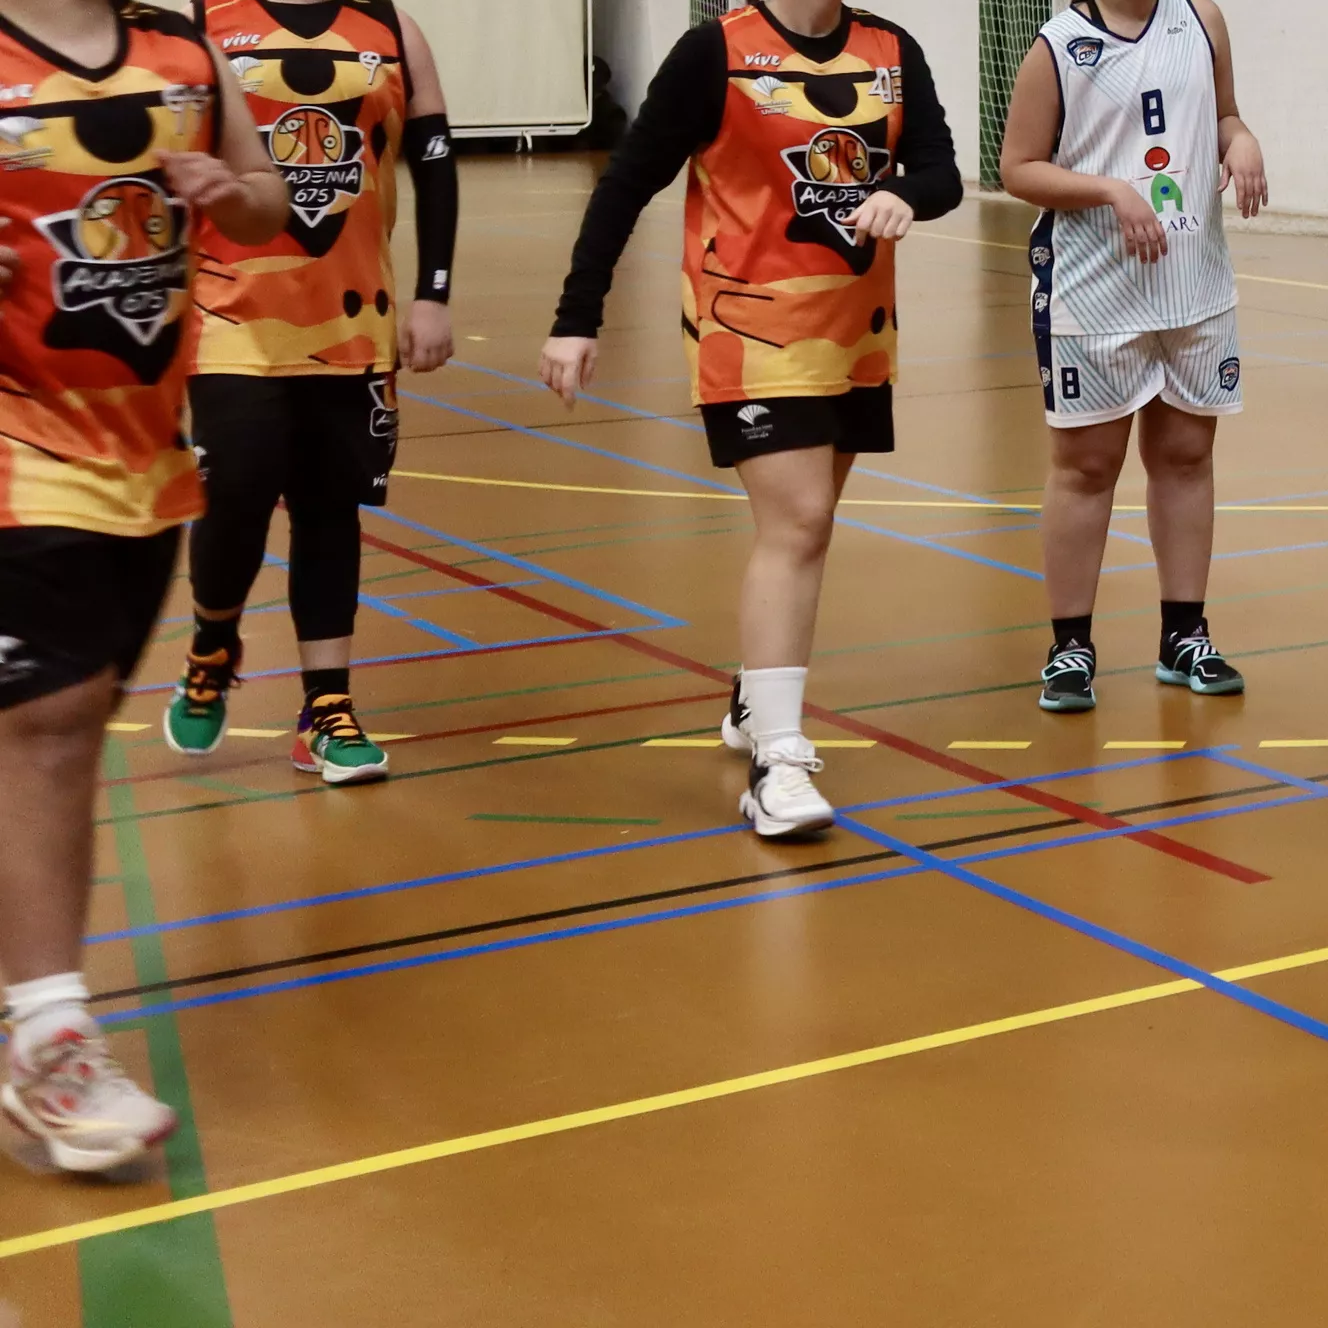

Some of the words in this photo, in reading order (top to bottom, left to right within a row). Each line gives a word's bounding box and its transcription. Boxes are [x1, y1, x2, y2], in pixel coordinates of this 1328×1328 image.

[359, 51, 382, 85] 9
[1141, 88, 1166, 136] 8
[281, 167, 359, 184] ADEMIA
[294, 187, 330, 203] 675
[1159, 215, 1200, 233] ARA
[1061, 367, 1081, 399] 8
